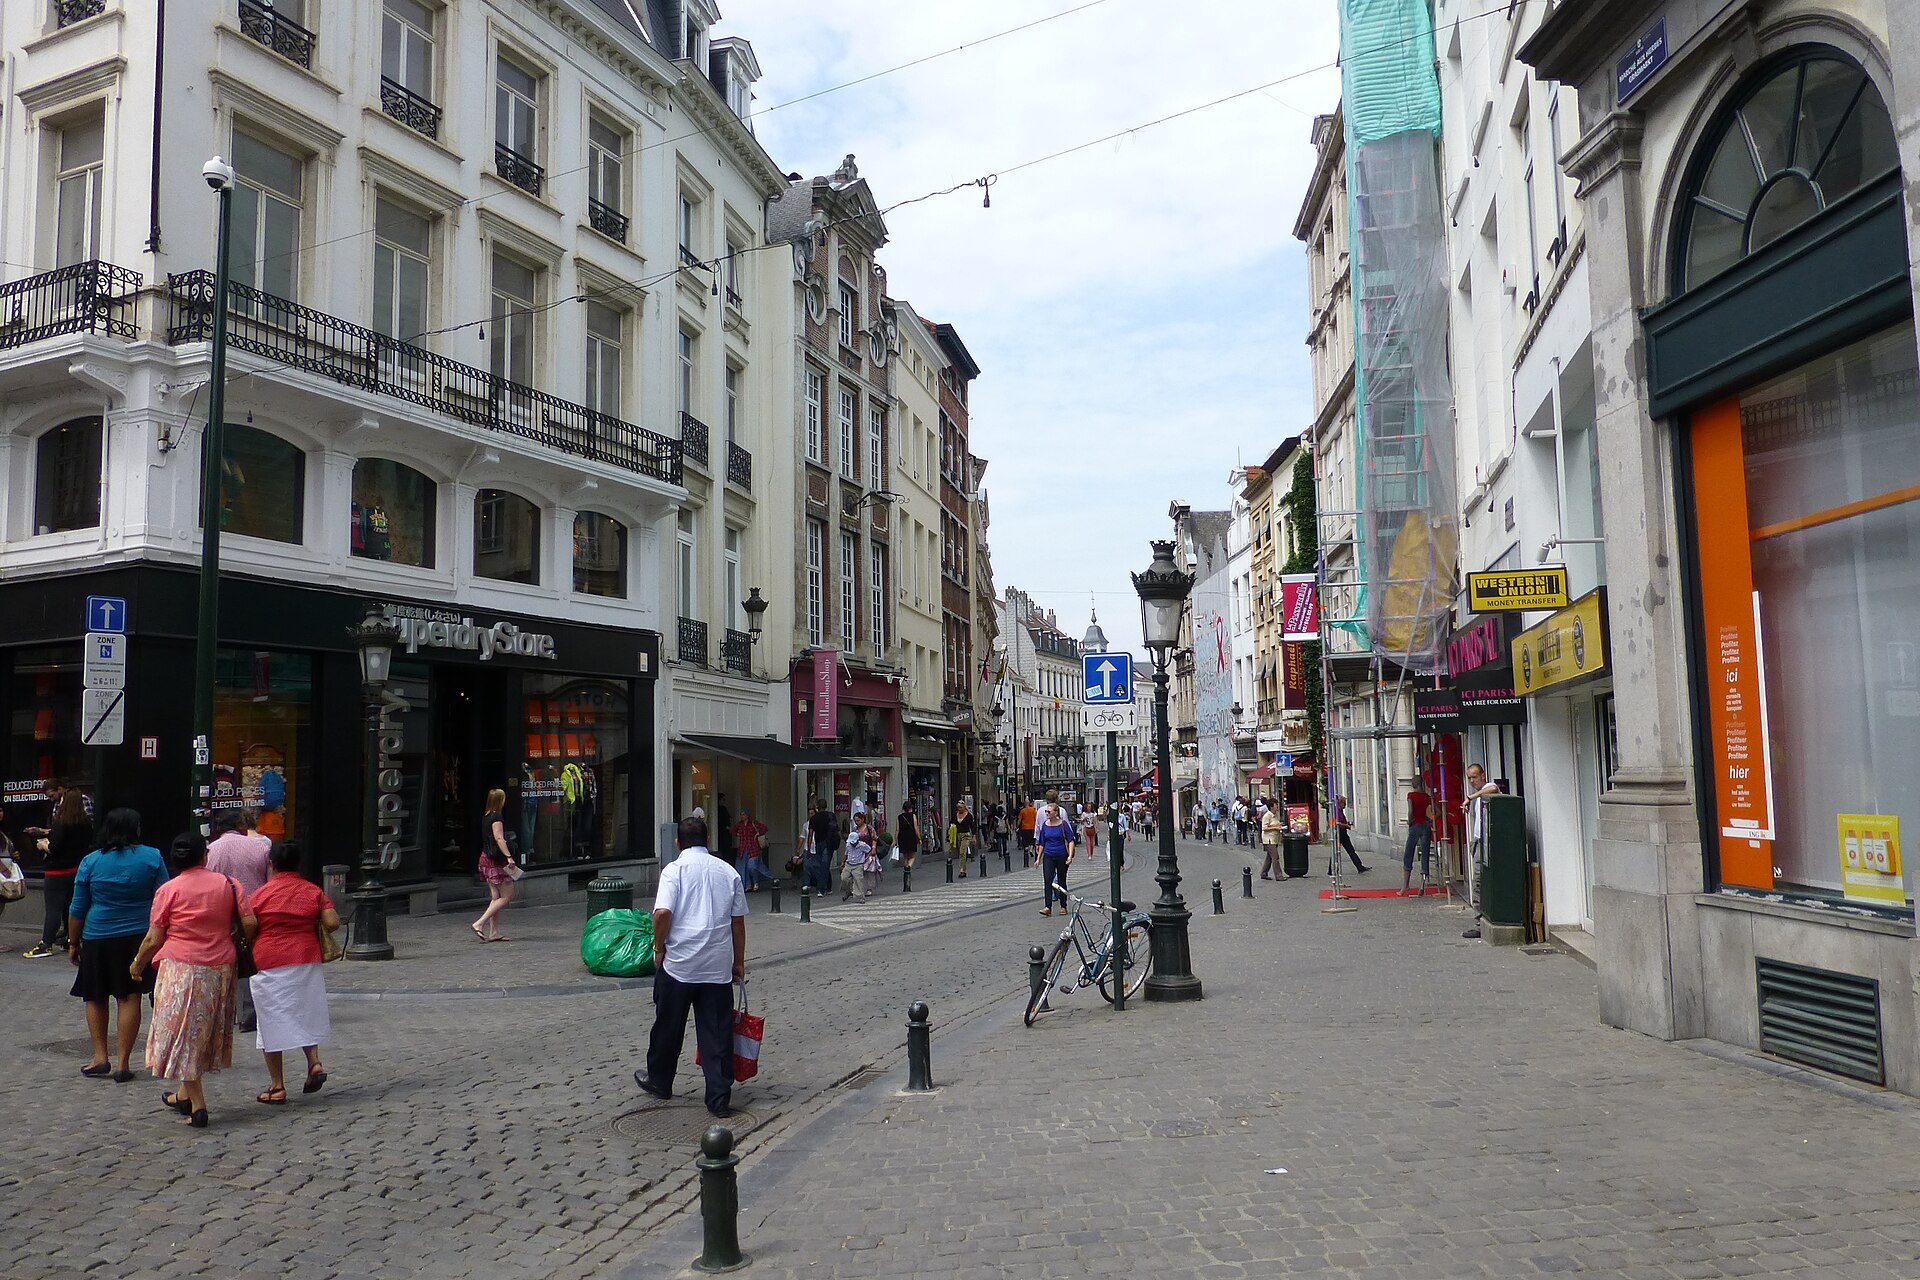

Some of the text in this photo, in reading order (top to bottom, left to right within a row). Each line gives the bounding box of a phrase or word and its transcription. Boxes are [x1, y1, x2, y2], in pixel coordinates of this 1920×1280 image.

[1476, 576, 1546, 589] WESTERN
[1498, 585, 1546, 597] UNION
[1517, 597, 1557, 605] TRANSFER
[97, 636, 116, 644] ZONE
[1726, 668, 1738, 682] ici
[1461, 688, 1516, 698] ICI PARIS X
[1417, 705, 1429, 713] ICI
[1430, 704, 1450, 712] PARIS
[953, 712, 970, 723] arche
[144, 740, 154, 755] H
[1729, 765, 1750, 779] hier
[4, 780, 32, 791] REDUCED
[521, 780, 547, 789] REDUCED
[236, 786, 265, 797] PRICES
[3, 795, 12, 803] ON
[12, 793, 39, 802] SELECTED
[211, 798, 265, 810] ELECTED ITEMS
